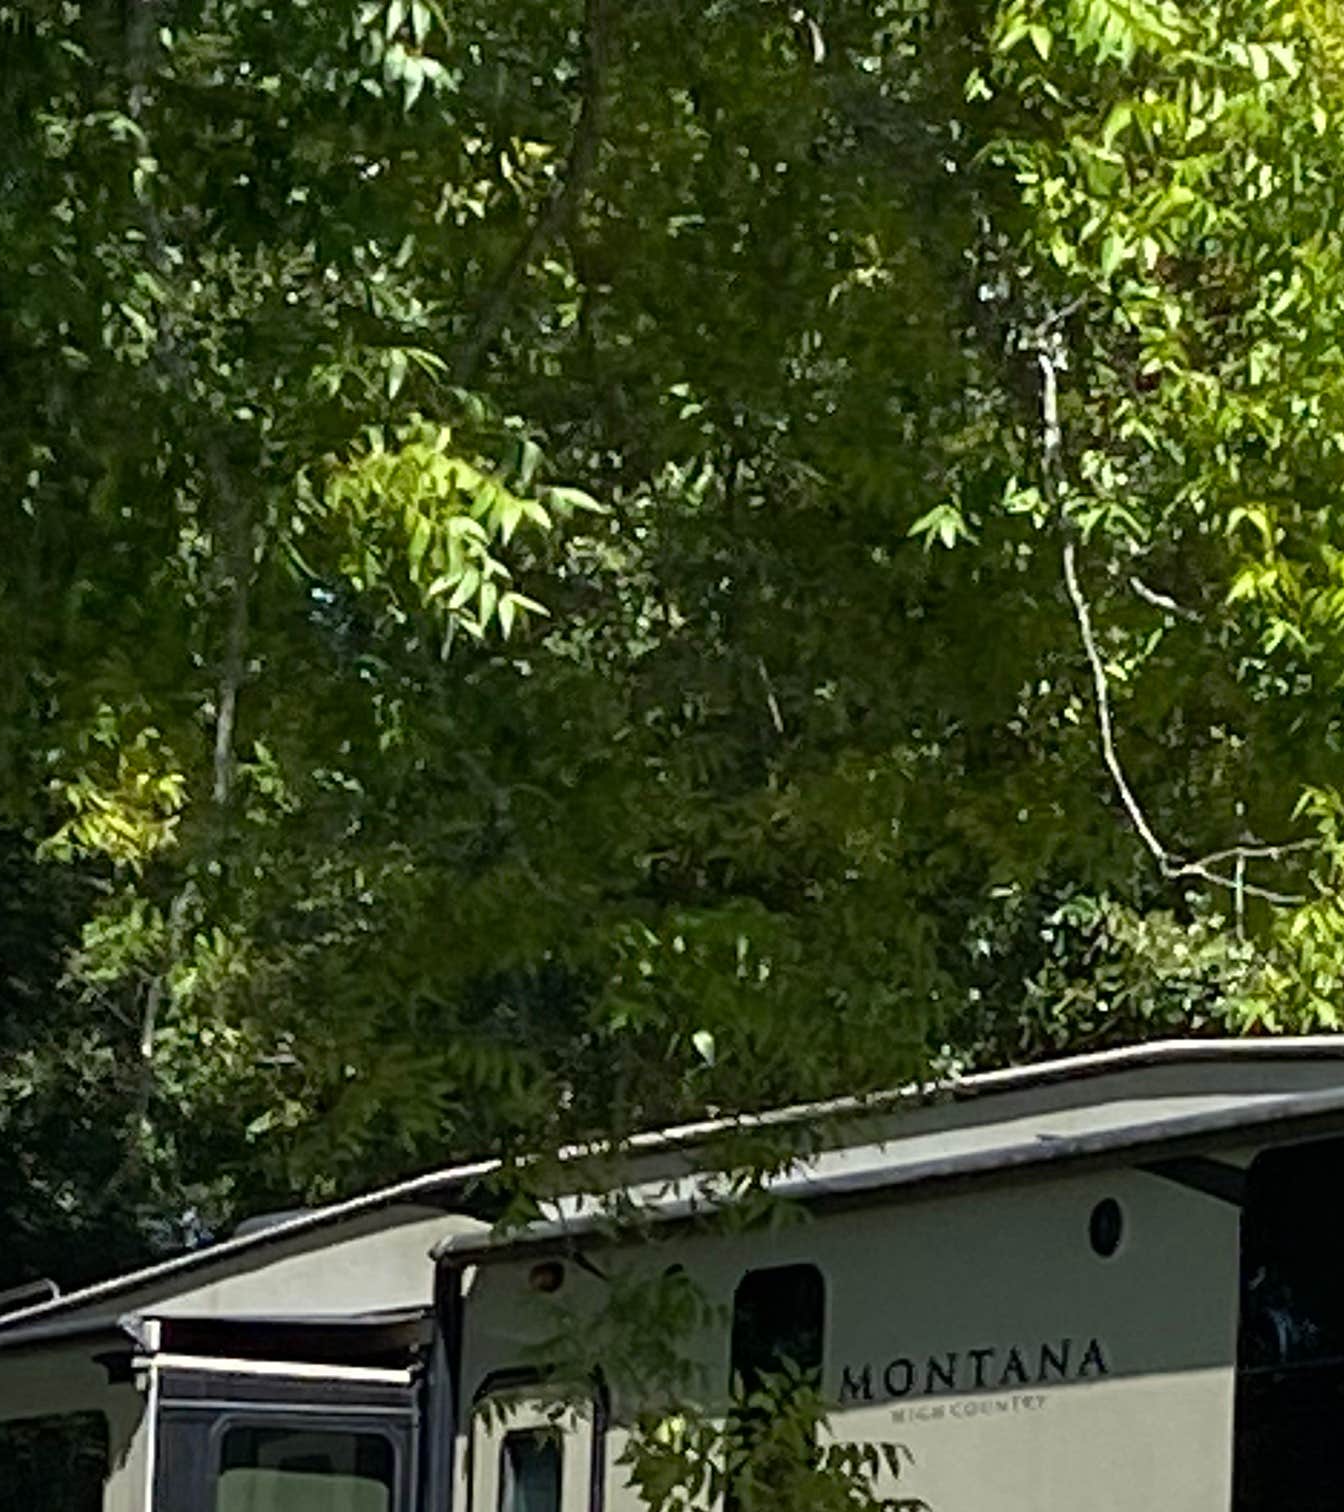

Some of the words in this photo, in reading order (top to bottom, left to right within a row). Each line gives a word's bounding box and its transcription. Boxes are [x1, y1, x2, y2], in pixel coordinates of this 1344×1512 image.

[838, 1338, 1109, 1403] MONTANA
[890, 1403, 946, 1424] HIGH
[949, 1395, 1047, 1419] COUNTRY
